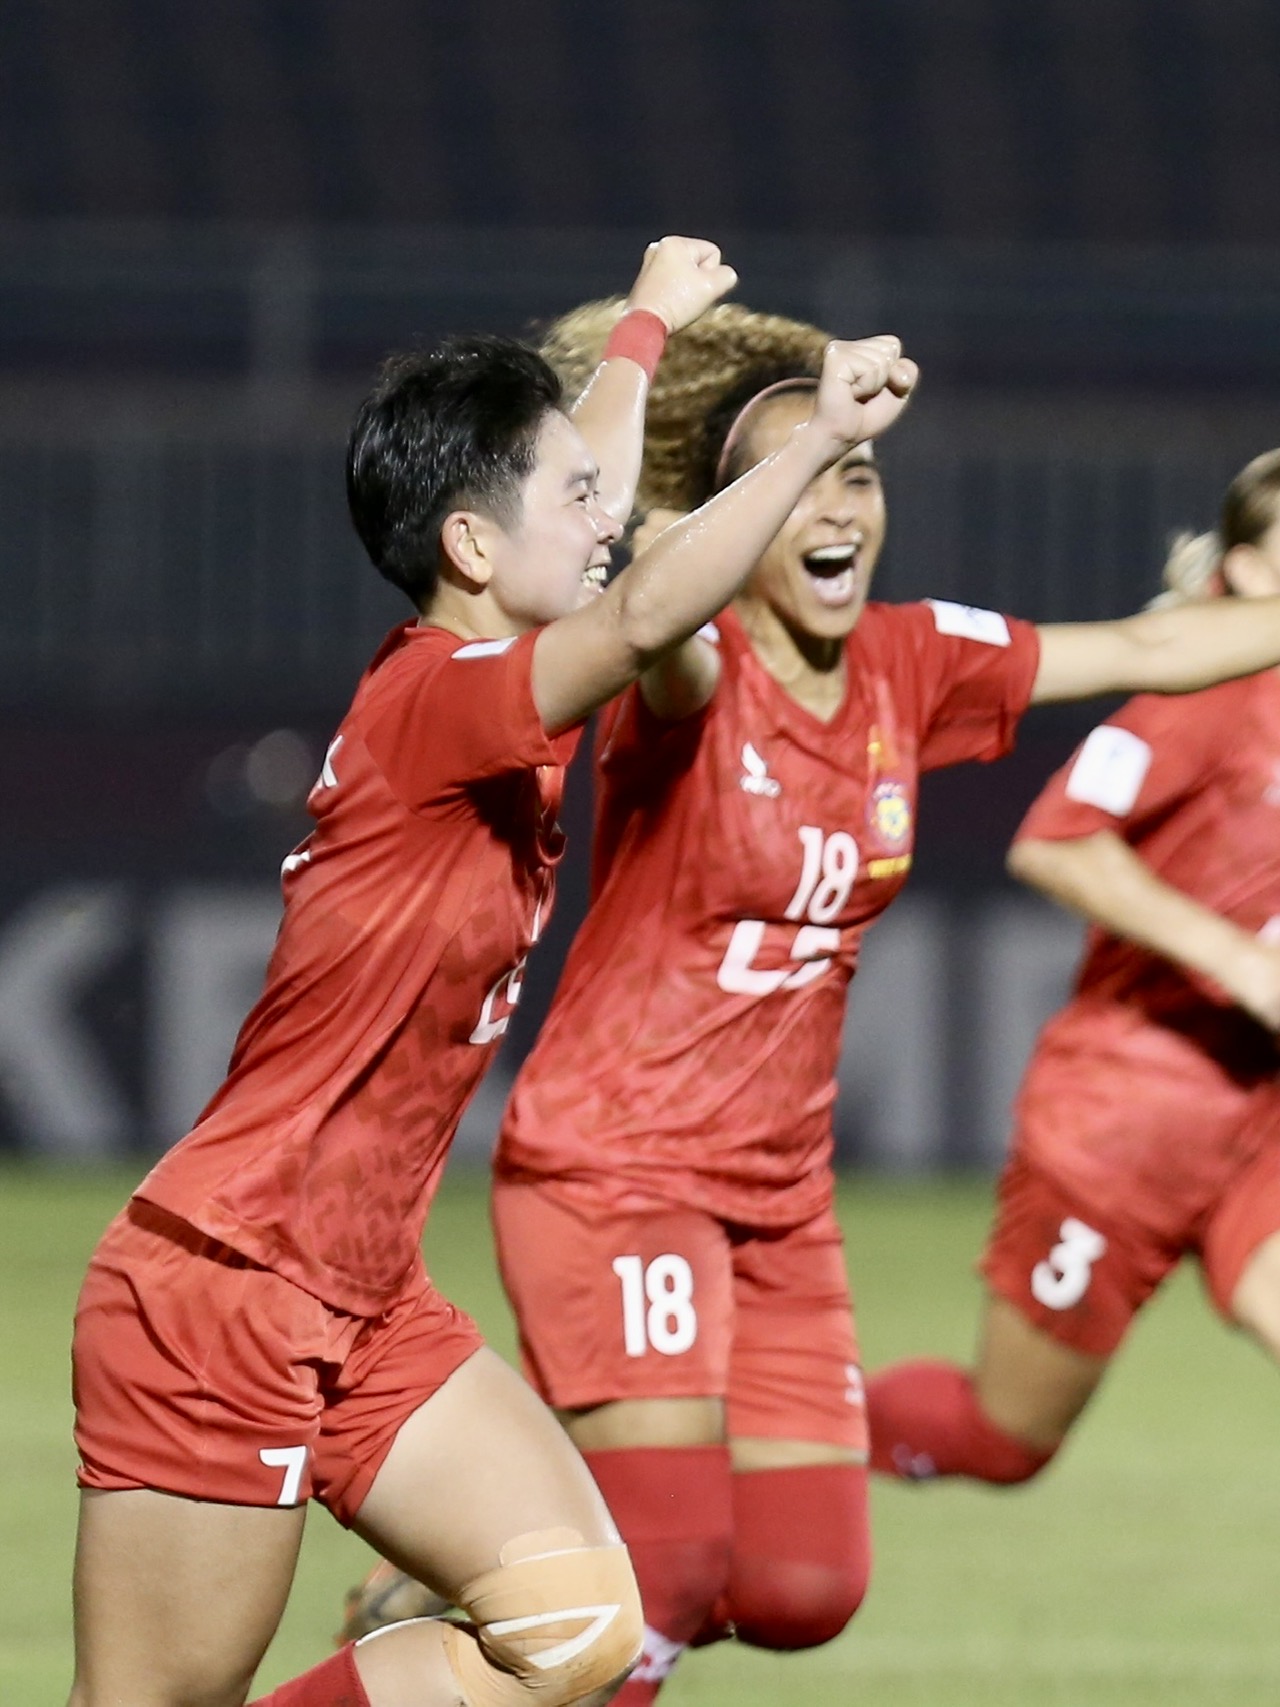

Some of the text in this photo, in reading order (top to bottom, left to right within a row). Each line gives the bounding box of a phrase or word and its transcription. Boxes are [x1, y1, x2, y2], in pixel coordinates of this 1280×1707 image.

[784, 825, 858, 924] 18
[613, 1253, 698, 1357] 18
[1031, 1217, 1106, 1310] 3
[259, 1445, 309, 1506] 7
